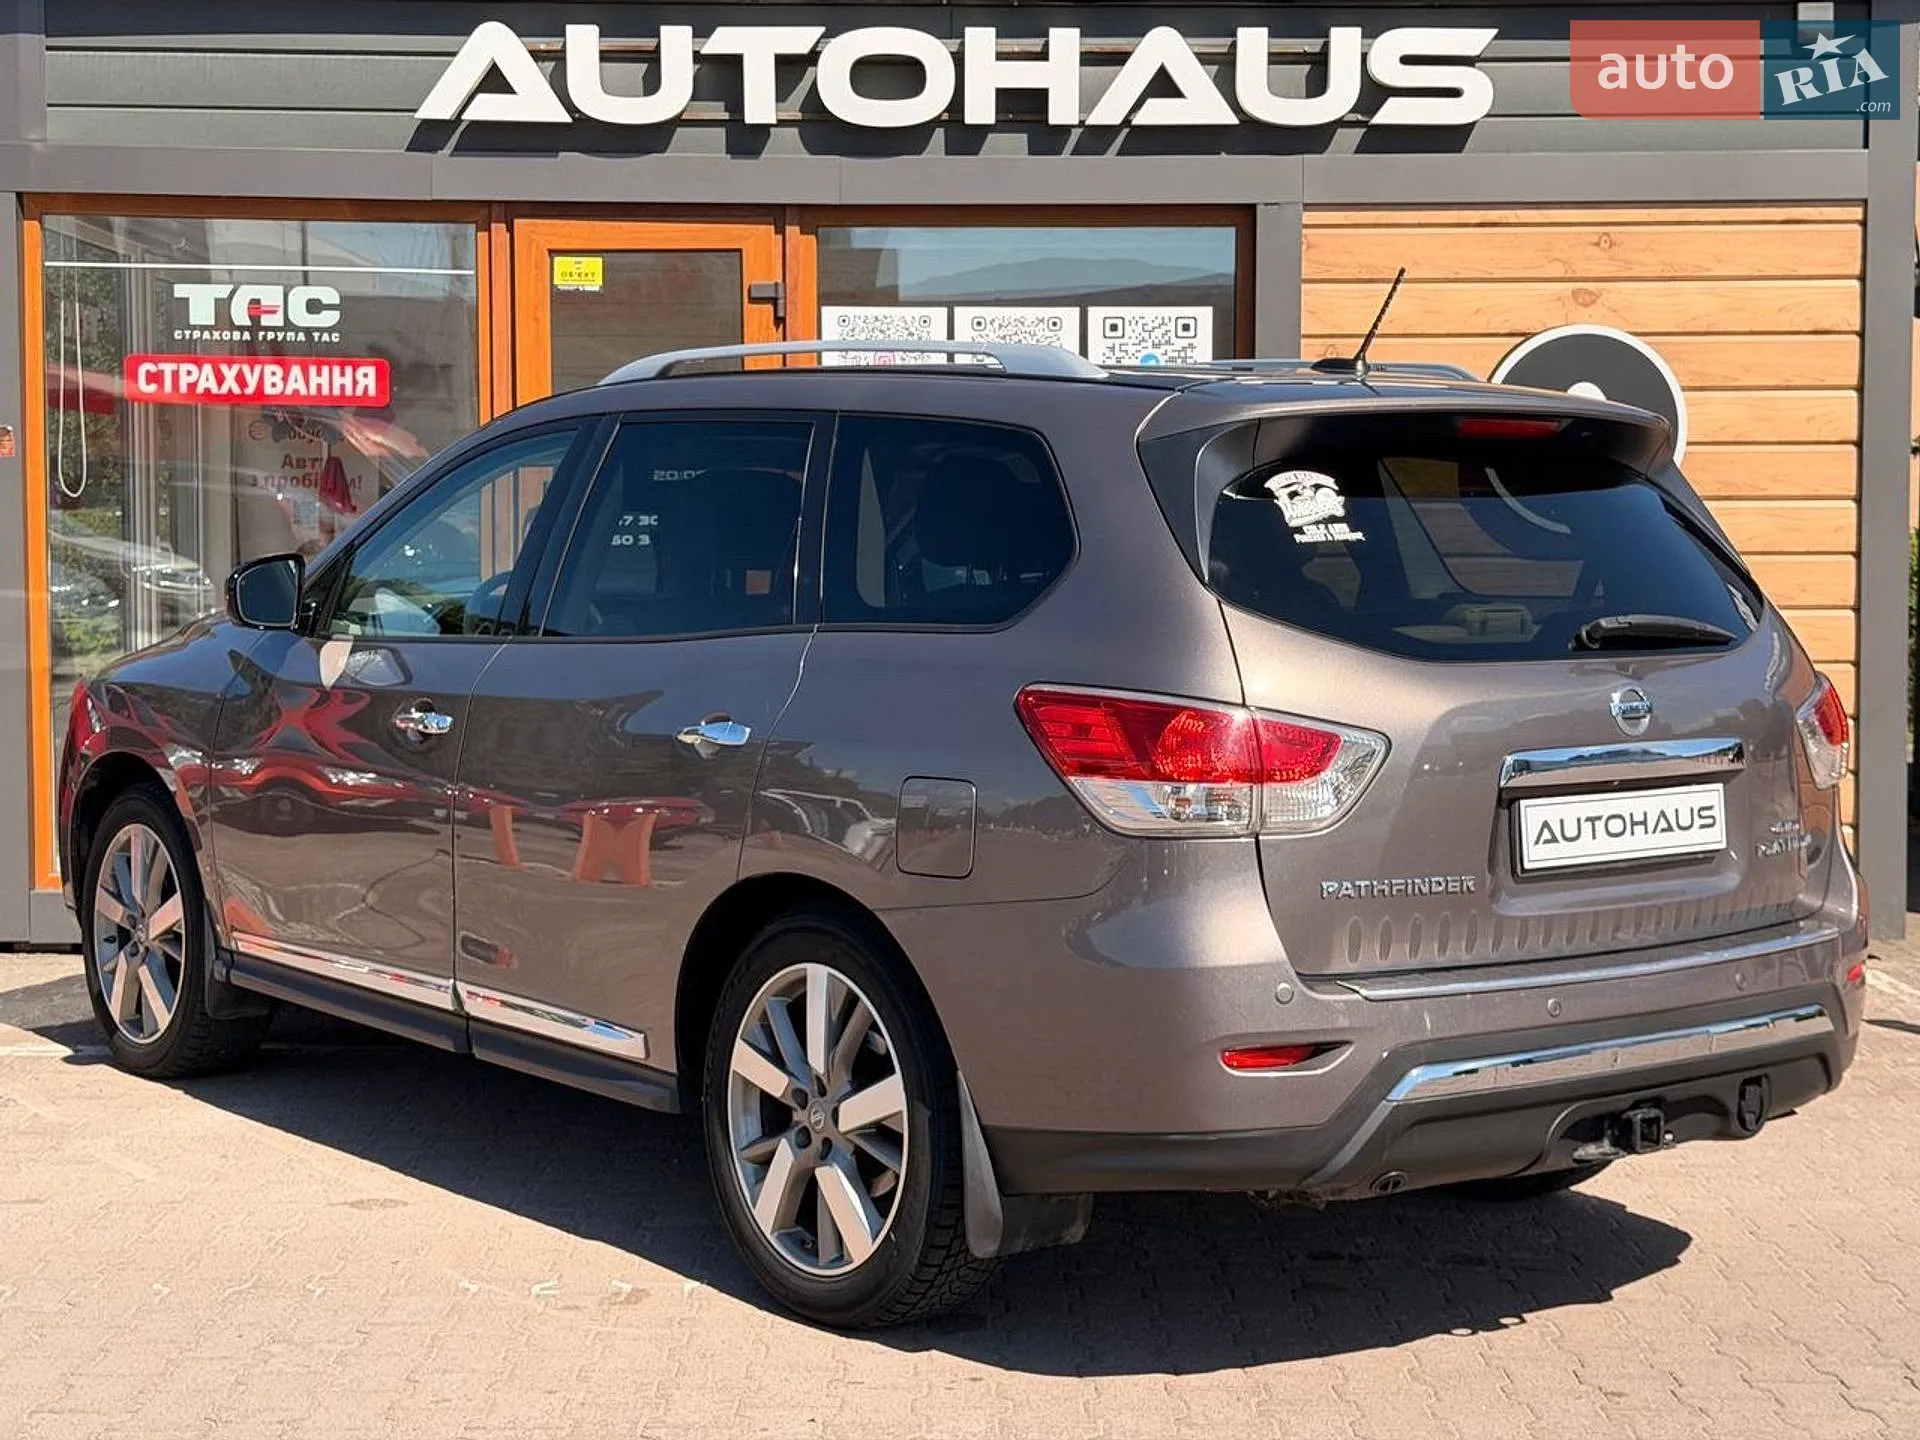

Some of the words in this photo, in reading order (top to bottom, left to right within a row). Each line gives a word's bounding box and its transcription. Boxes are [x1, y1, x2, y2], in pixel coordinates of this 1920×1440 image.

[414, 20, 1499, 127] AUTOHAUS
[173, 284, 341, 327] ТАС
[174, 329, 252, 341] СТРАХОВА
[258, 331, 306, 342] ГРУПА
[312, 332, 341, 343] ТАС
[137, 362, 377, 398] СТРАХУВАННЯ
[281, 453, 323, 470] Авт
[1533, 804, 1717, 846] AUTOHAUS
[1320, 875, 1476, 899] PATHFINDER
